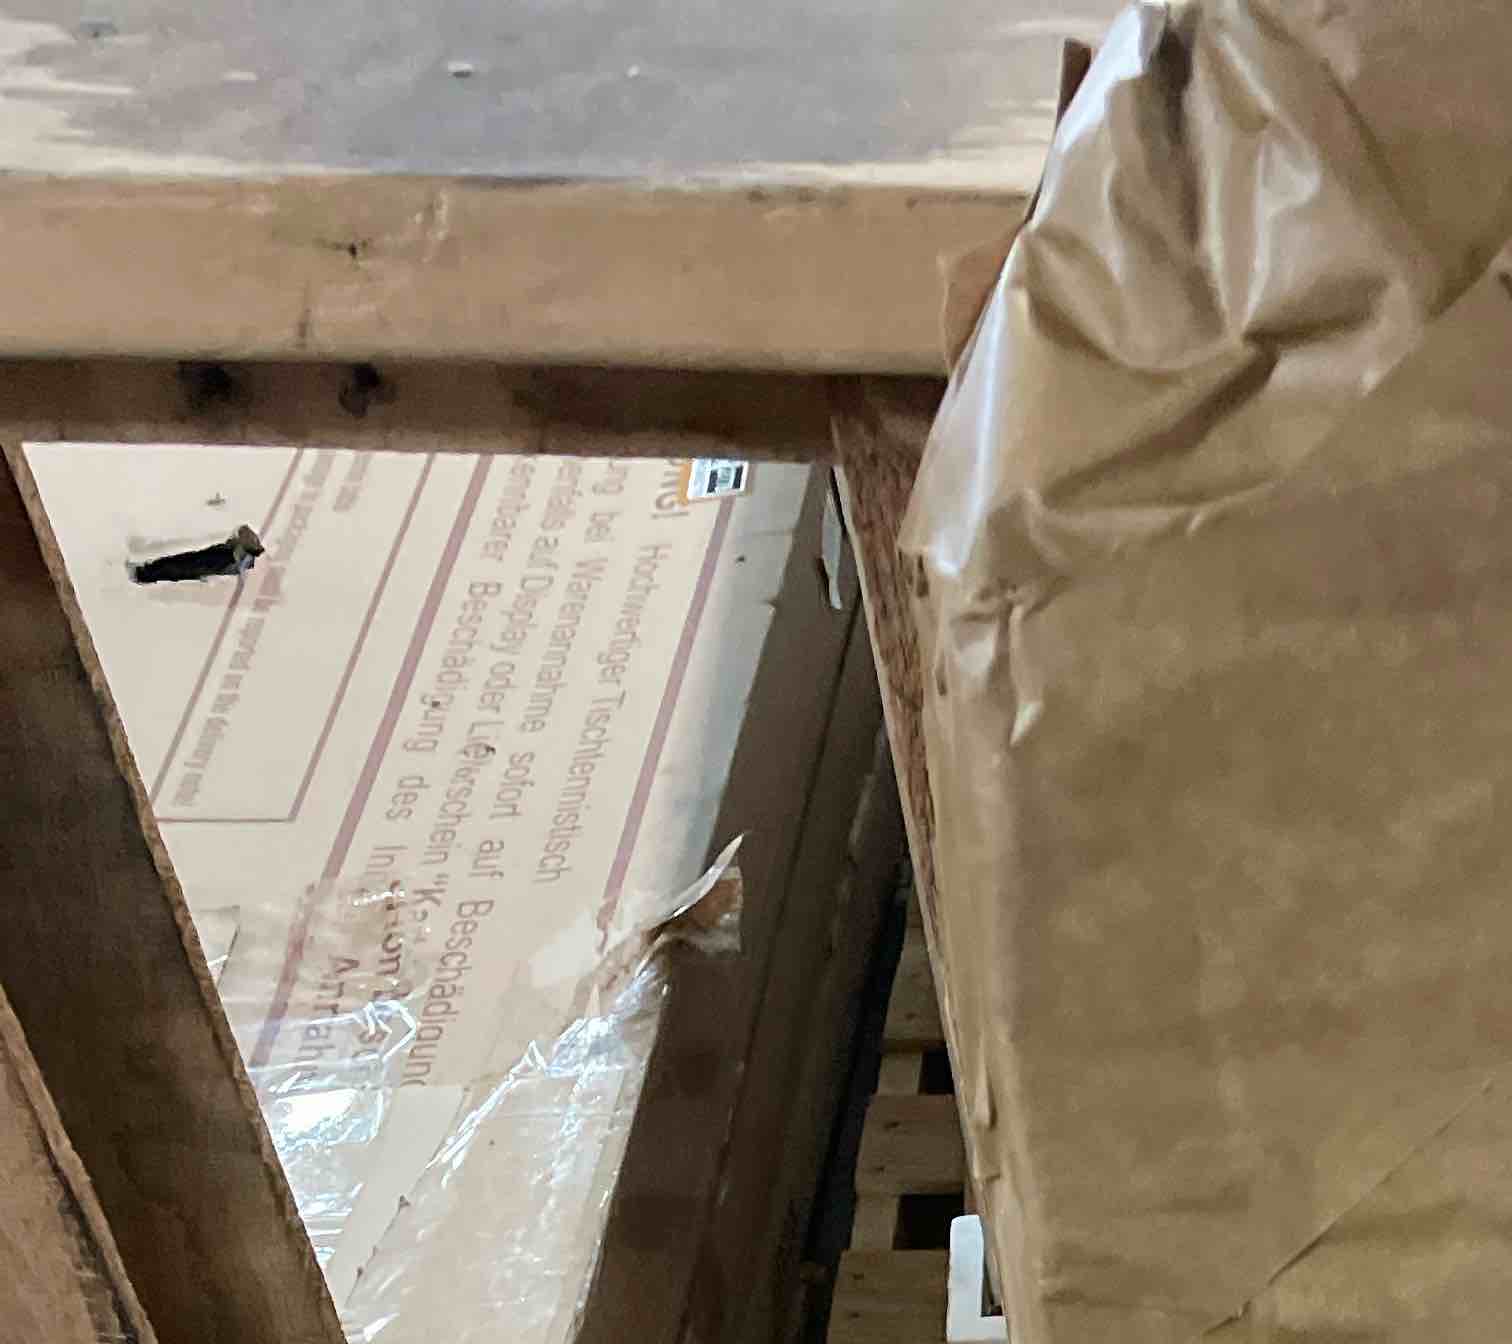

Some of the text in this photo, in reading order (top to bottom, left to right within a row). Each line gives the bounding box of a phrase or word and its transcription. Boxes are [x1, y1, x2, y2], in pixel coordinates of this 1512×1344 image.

[584, 510, 620, 543] bei
[490, 576, 554, 656] Display
[519, 557, 608, 732] Warenannahme
[597, 543, 672, 685] Hochwertiger
[402, 581, 502, 752] Beschädigung
[477, 661, 516, 713] oder
[386, 775, 430, 821] des
[489, 751, 535, 819] sofort
[532, 690, 626, 884] Tischtennistisch
[468, 839, 504, 879] auf
